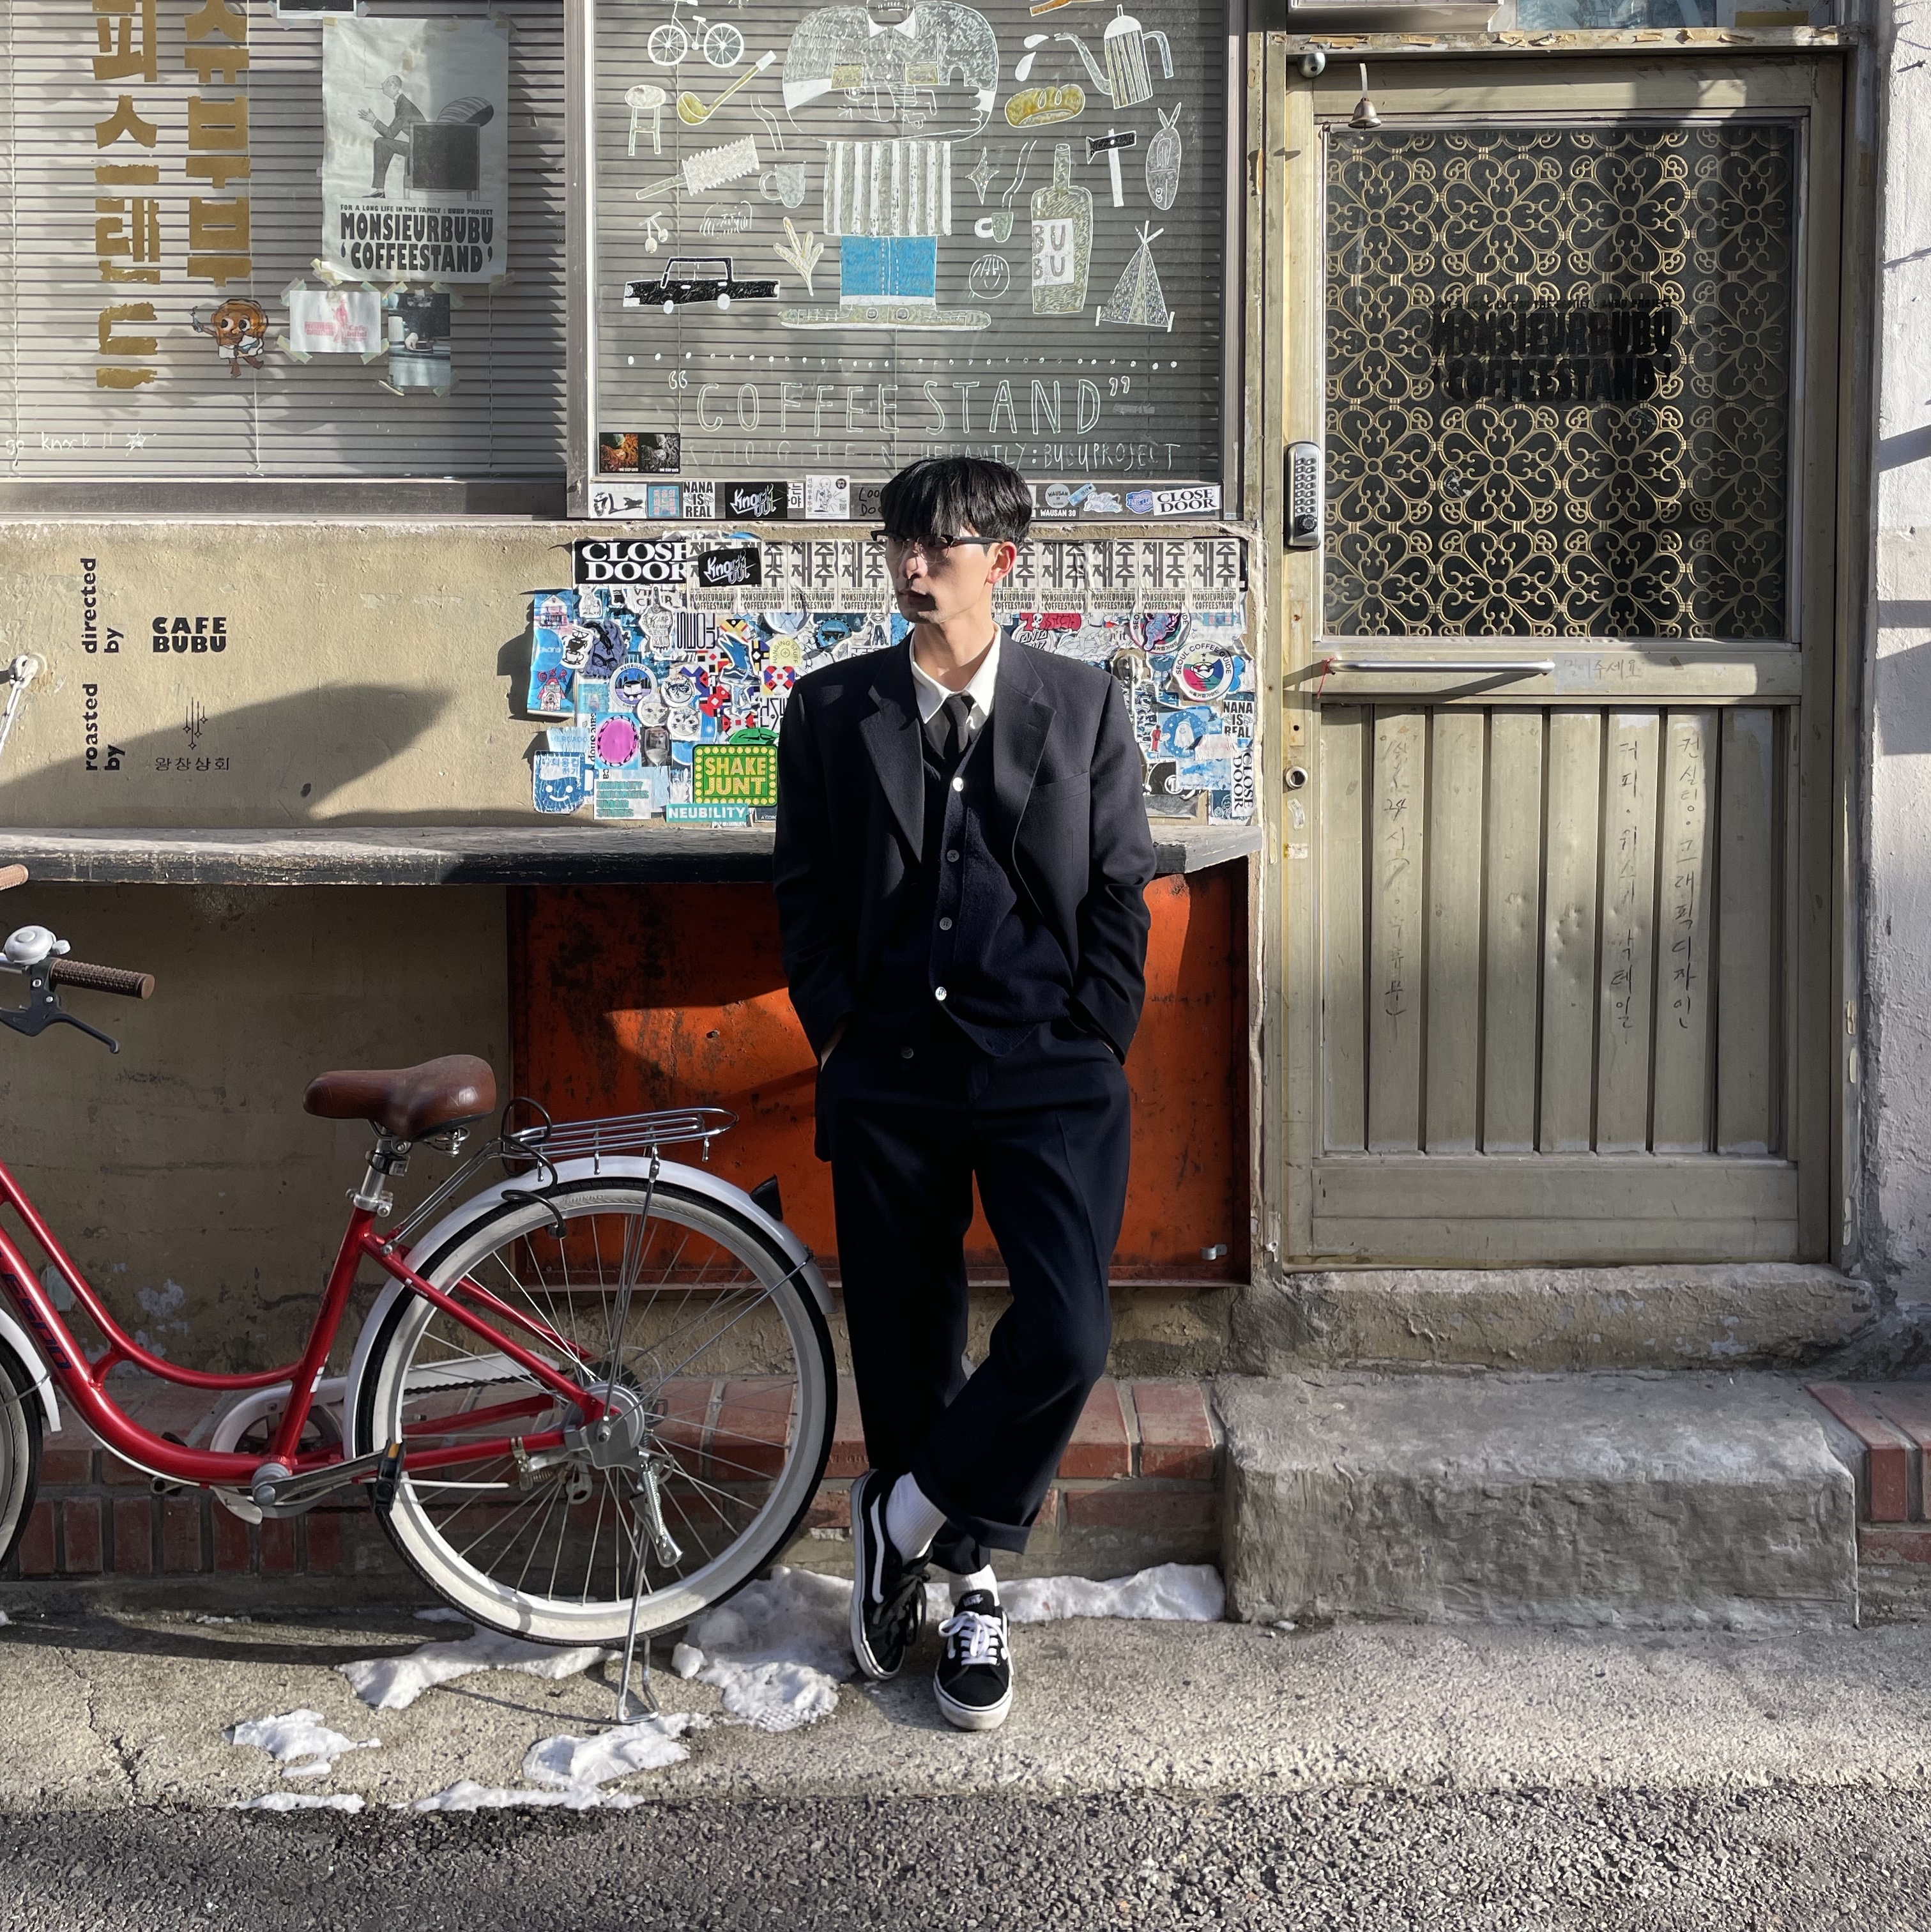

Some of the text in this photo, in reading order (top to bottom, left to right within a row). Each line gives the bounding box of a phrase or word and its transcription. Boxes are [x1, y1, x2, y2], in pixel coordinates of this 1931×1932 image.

[340, 213, 493, 244] MONSIEURBUBU
[1033, 225, 1065, 254] BU
[1033, 256, 1065, 280] BU
[1433, 311, 1672, 356] MONSIEURBUBU
[42, 431, 91, 451] knock
[683, 481, 713, 493] NANA
[859, 487, 880, 502] LOO
[693, 494, 703, 505] IS
[1157, 489, 1214, 503] CLOSE
[685, 505, 712, 518] REAL
[1159, 499, 1217, 512] DOOR
[585, 562, 686, 581] DOOR
[690, 593, 734, 601] MONSIEURBUBU
[740, 593, 784, 601] MONSIEURBUBU
[791, 593, 834, 601] MONSIEURBUBU
[841, 593, 885, 601] MONSIEURBUBU
[992, 593, 1035, 602] MONSIEURBUBU
[1041, 593, 1085, 601] MONSIEURBUBU
[1092, 593, 1135, 601] MONSIEURBUBU
[1142, 593, 1186, 601] MONSIEURBUBU
[1193, 593, 1236, 601] MONSIEURBUBU
[80, 558, 97, 653] directed
[152, 617, 227, 634] CAFE
[104, 627, 124, 653] by
[153, 636, 227, 653] BUBU
[773, 641, 799, 664] HANGING STUFF
[1177, 643, 1232, 675] SEOUL COFFEE GUIDE
[1223, 702, 1253, 714] NANA
[82, 684, 98, 770] roasted
[1232, 714, 1244, 726] IS
[1225, 726, 1251, 738] REAL
[104, 744, 125, 770] by
[155, 757, 230, 772] 왕창상회
[705, 757, 767, 776] SHAKE
[705, 777, 766, 795] JUNT
[1233, 755, 1244, 811] DOOR
[1242, 752, 1253, 809] CLOSE
[668, 807, 746, 818] NEUBILITY
